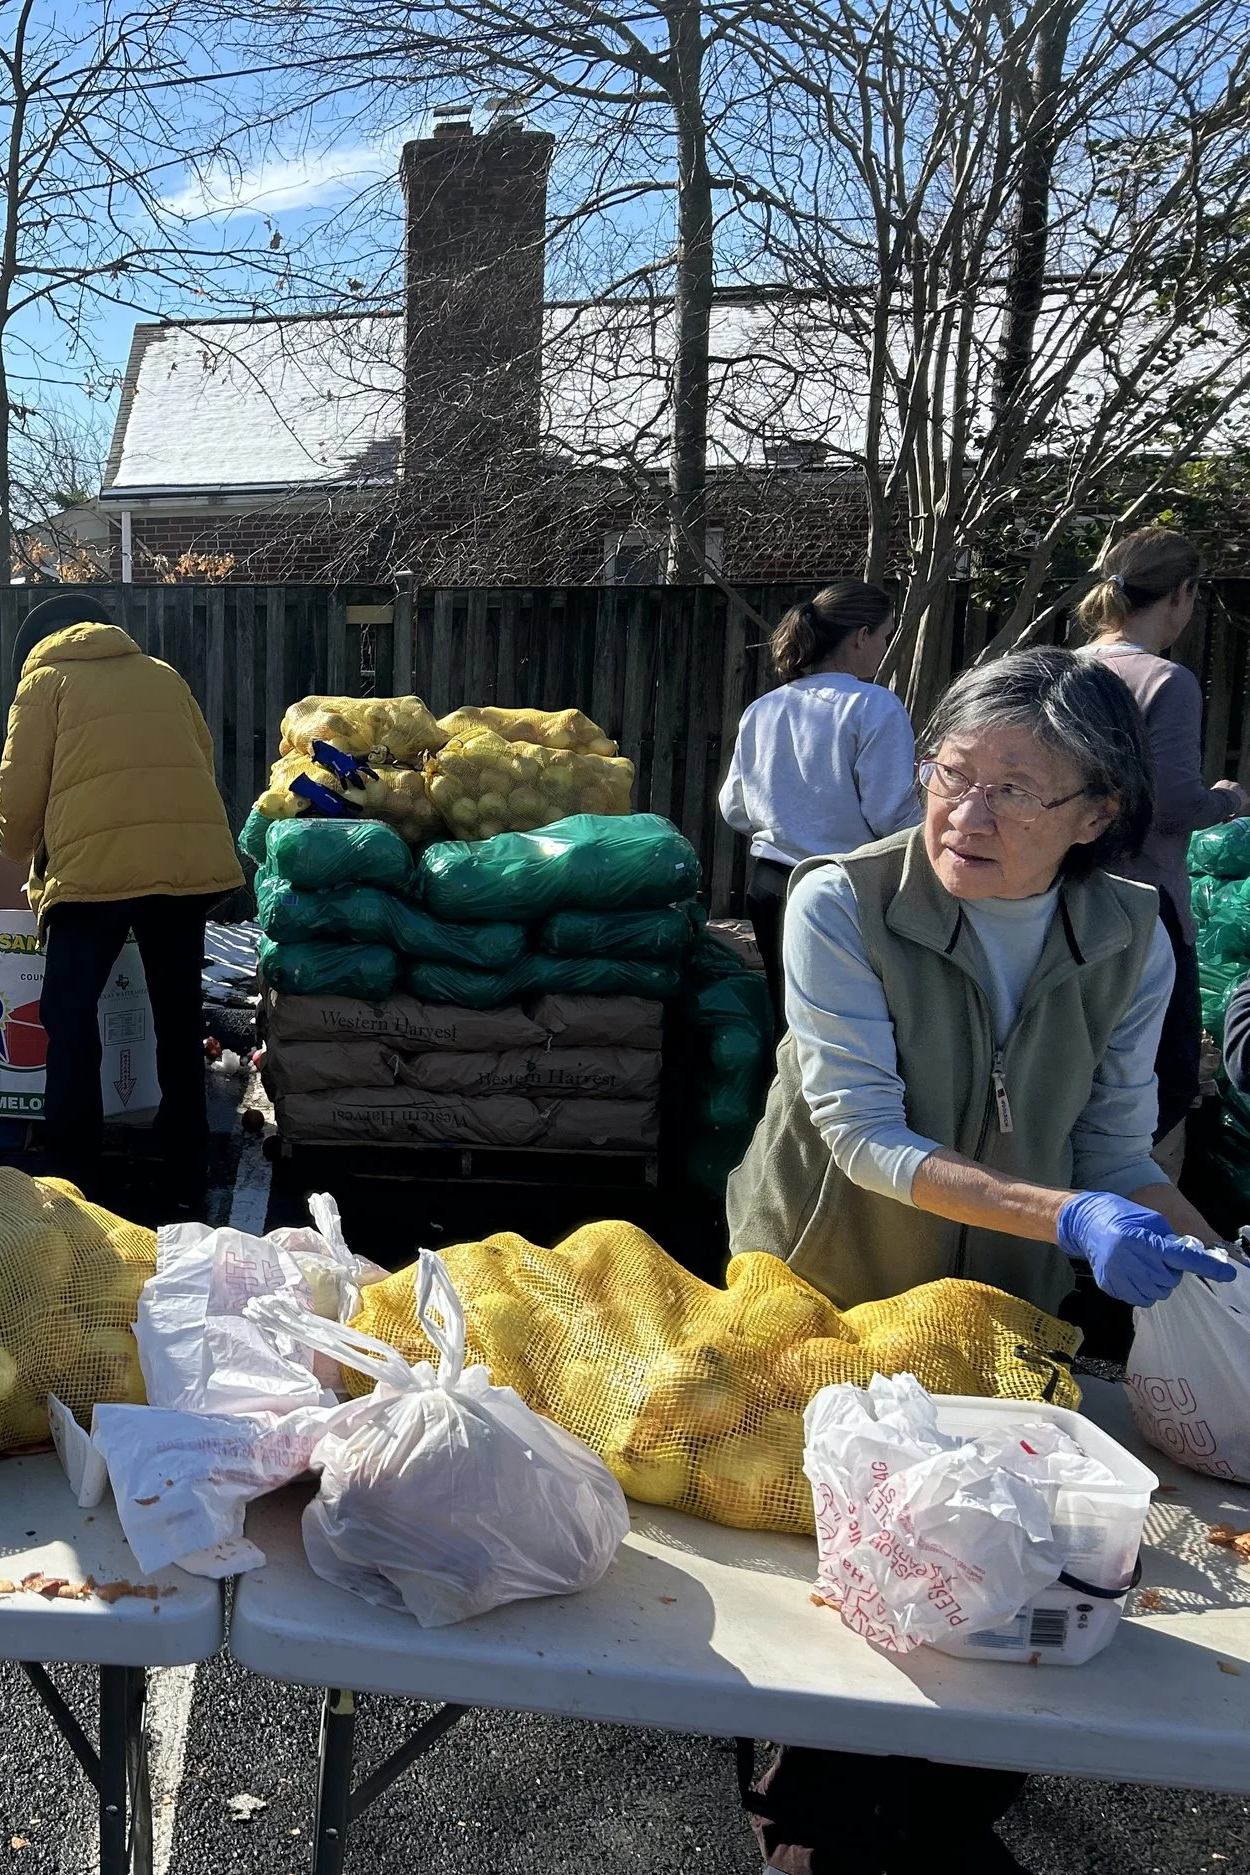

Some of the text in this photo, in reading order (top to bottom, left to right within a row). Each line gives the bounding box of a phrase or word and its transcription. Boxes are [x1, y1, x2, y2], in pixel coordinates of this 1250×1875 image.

[20, 973, 46, 981] COUN
[321, 1010, 457, 1042] Western Harvest
[477, 1068, 616, 1087] Western Harvest
[332, 1108, 467, 1128] Western Harvest
